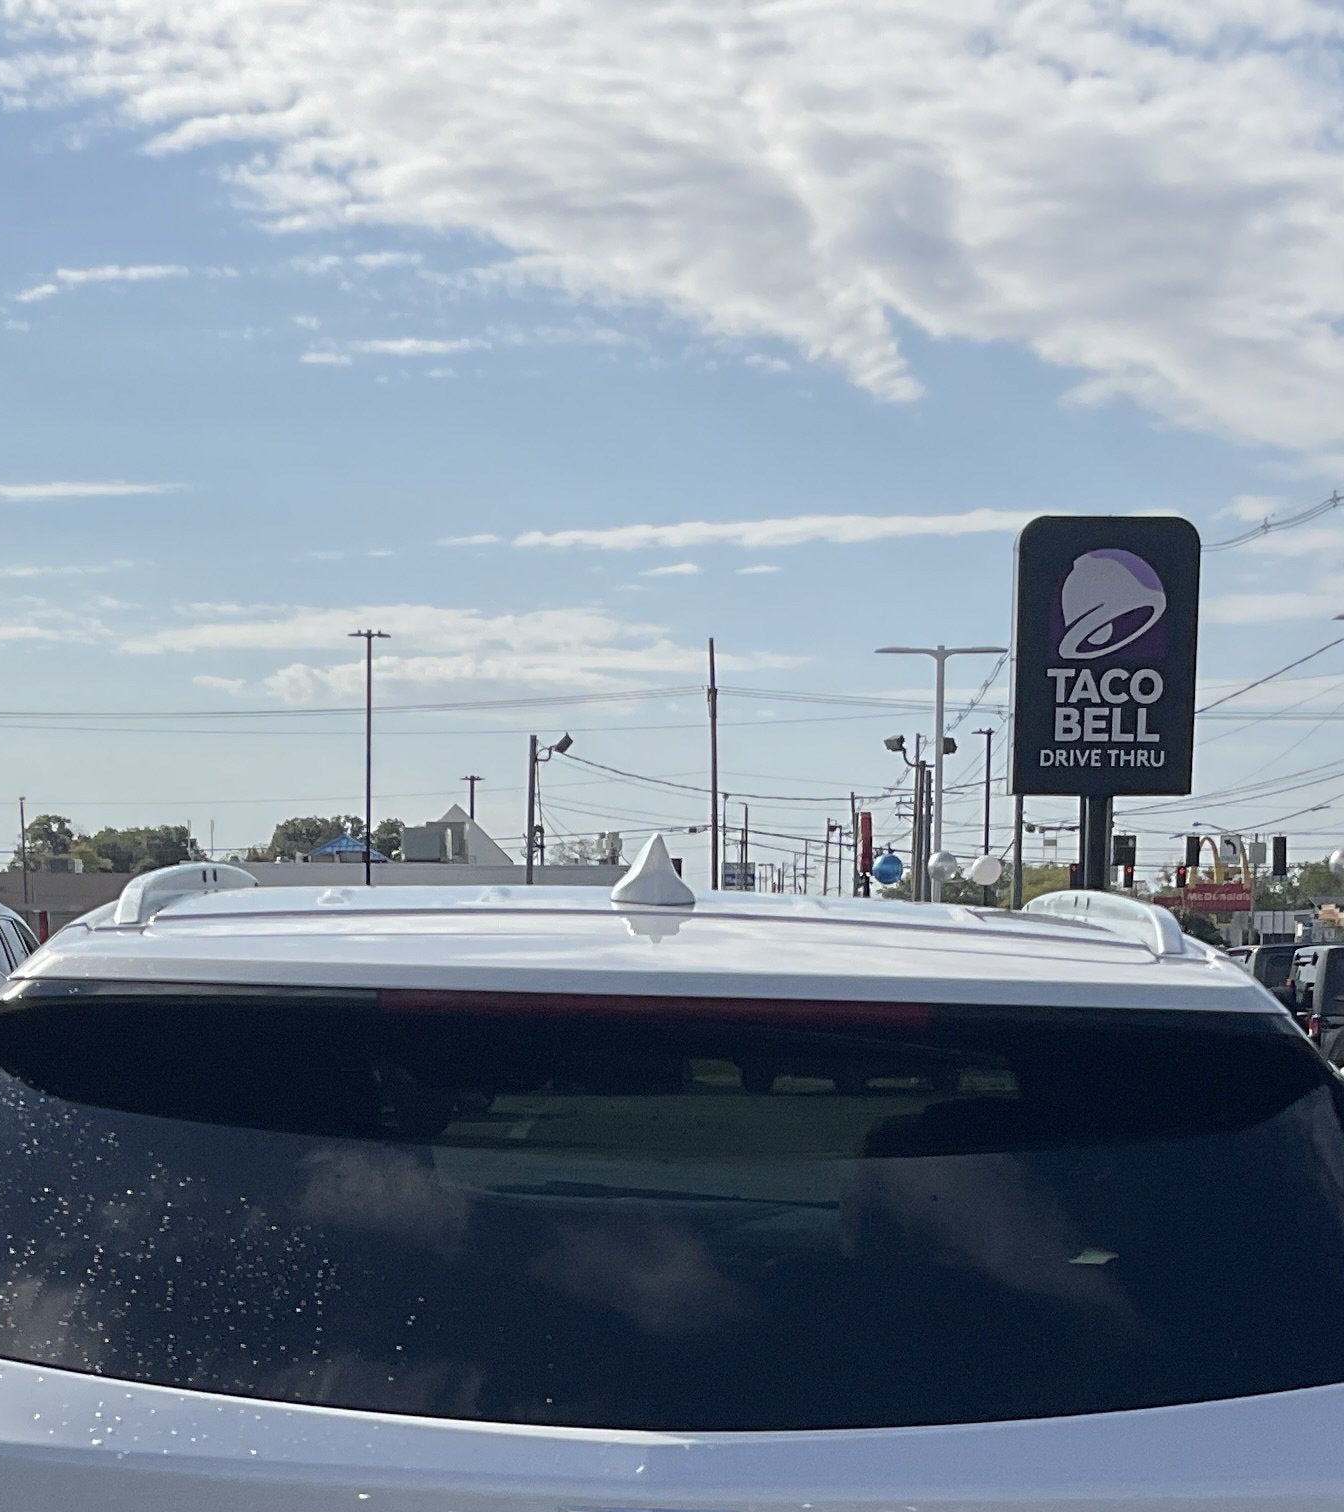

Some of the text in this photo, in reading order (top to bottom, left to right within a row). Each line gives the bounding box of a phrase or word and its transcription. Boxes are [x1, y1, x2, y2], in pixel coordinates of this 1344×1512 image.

[1047, 668, 1164, 705] TACO
[1054, 707, 1160, 743] BELL
[1039, 749, 1166, 768] DRIVE THRU
